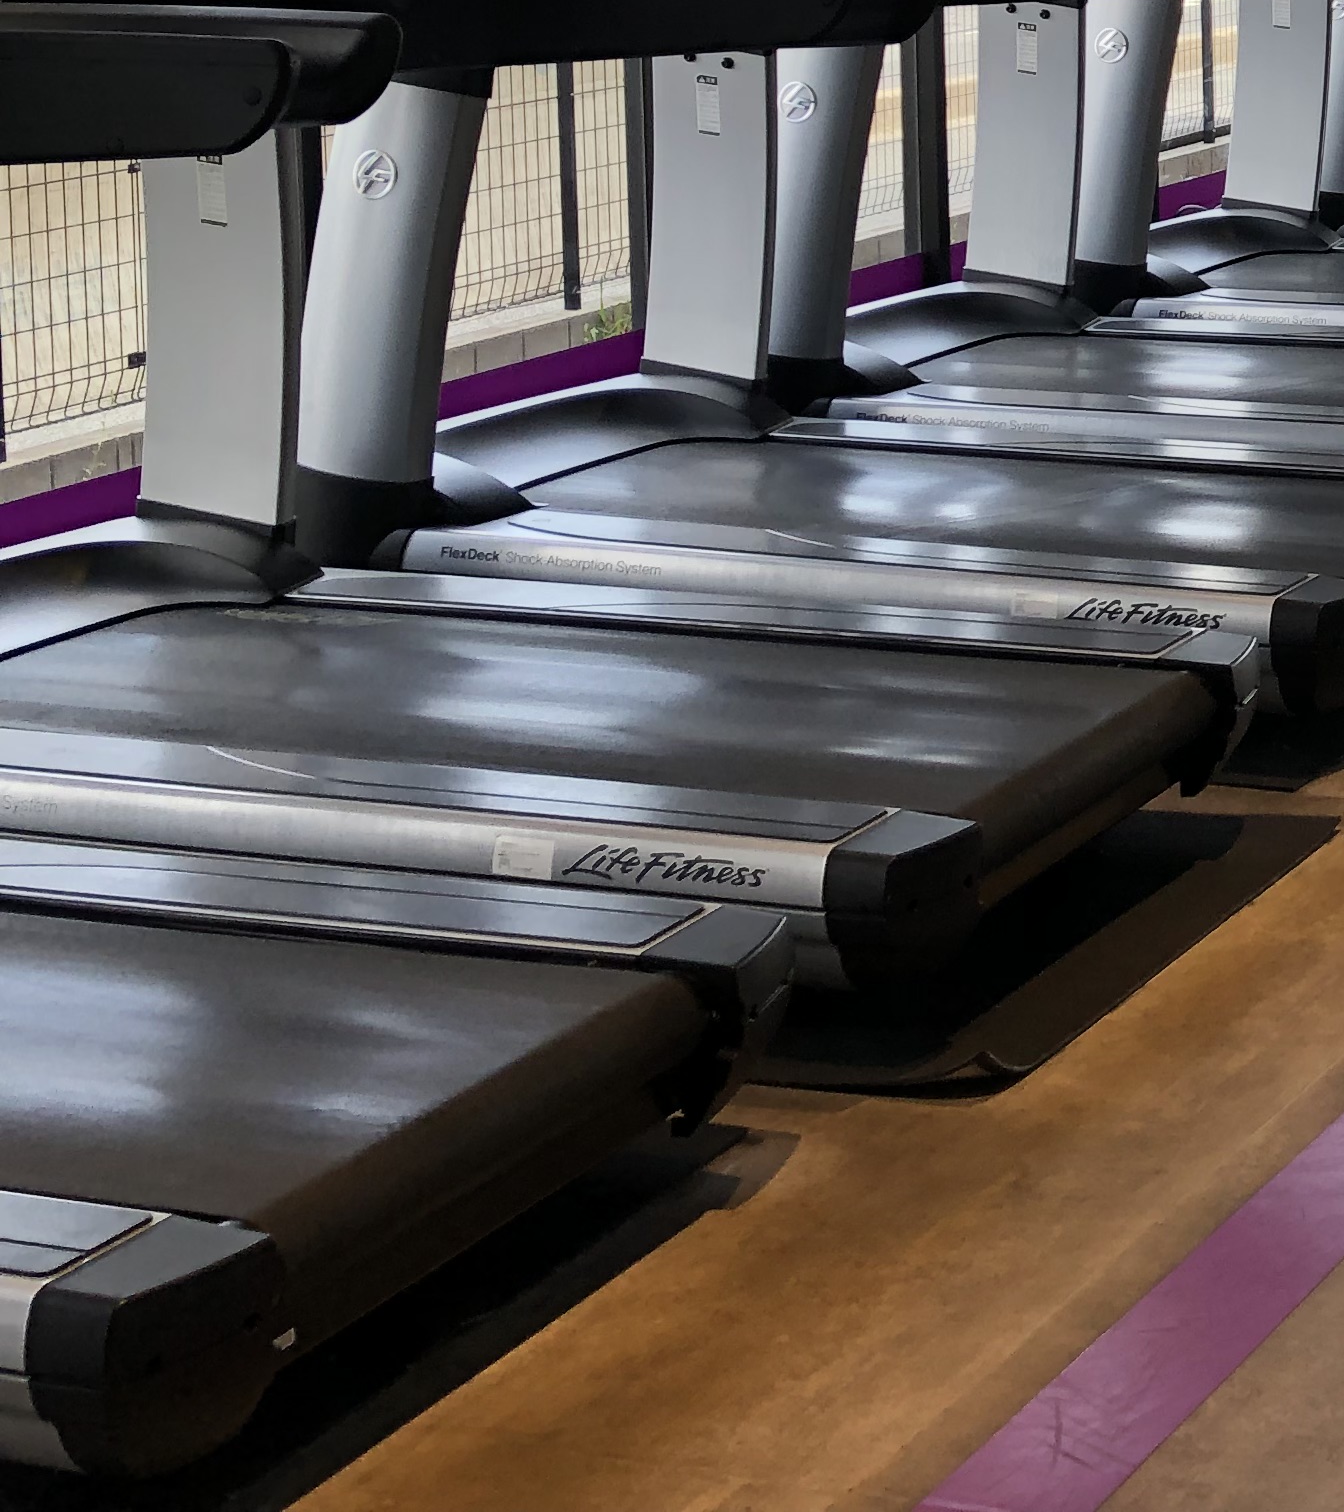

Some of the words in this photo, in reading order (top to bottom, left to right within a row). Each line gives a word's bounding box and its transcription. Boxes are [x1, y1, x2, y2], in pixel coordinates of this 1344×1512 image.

[1159, 310, 1203, 319] FlexDeck
[856, 412, 908, 423] FlexDeck
[912, 414, 945, 426] Shock
[440, 546, 500, 563] FlexDeck
[505, 550, 543, 565] Shock
[546, 554, 613, 572] Absorption
[615, 559, 662, 576] System
